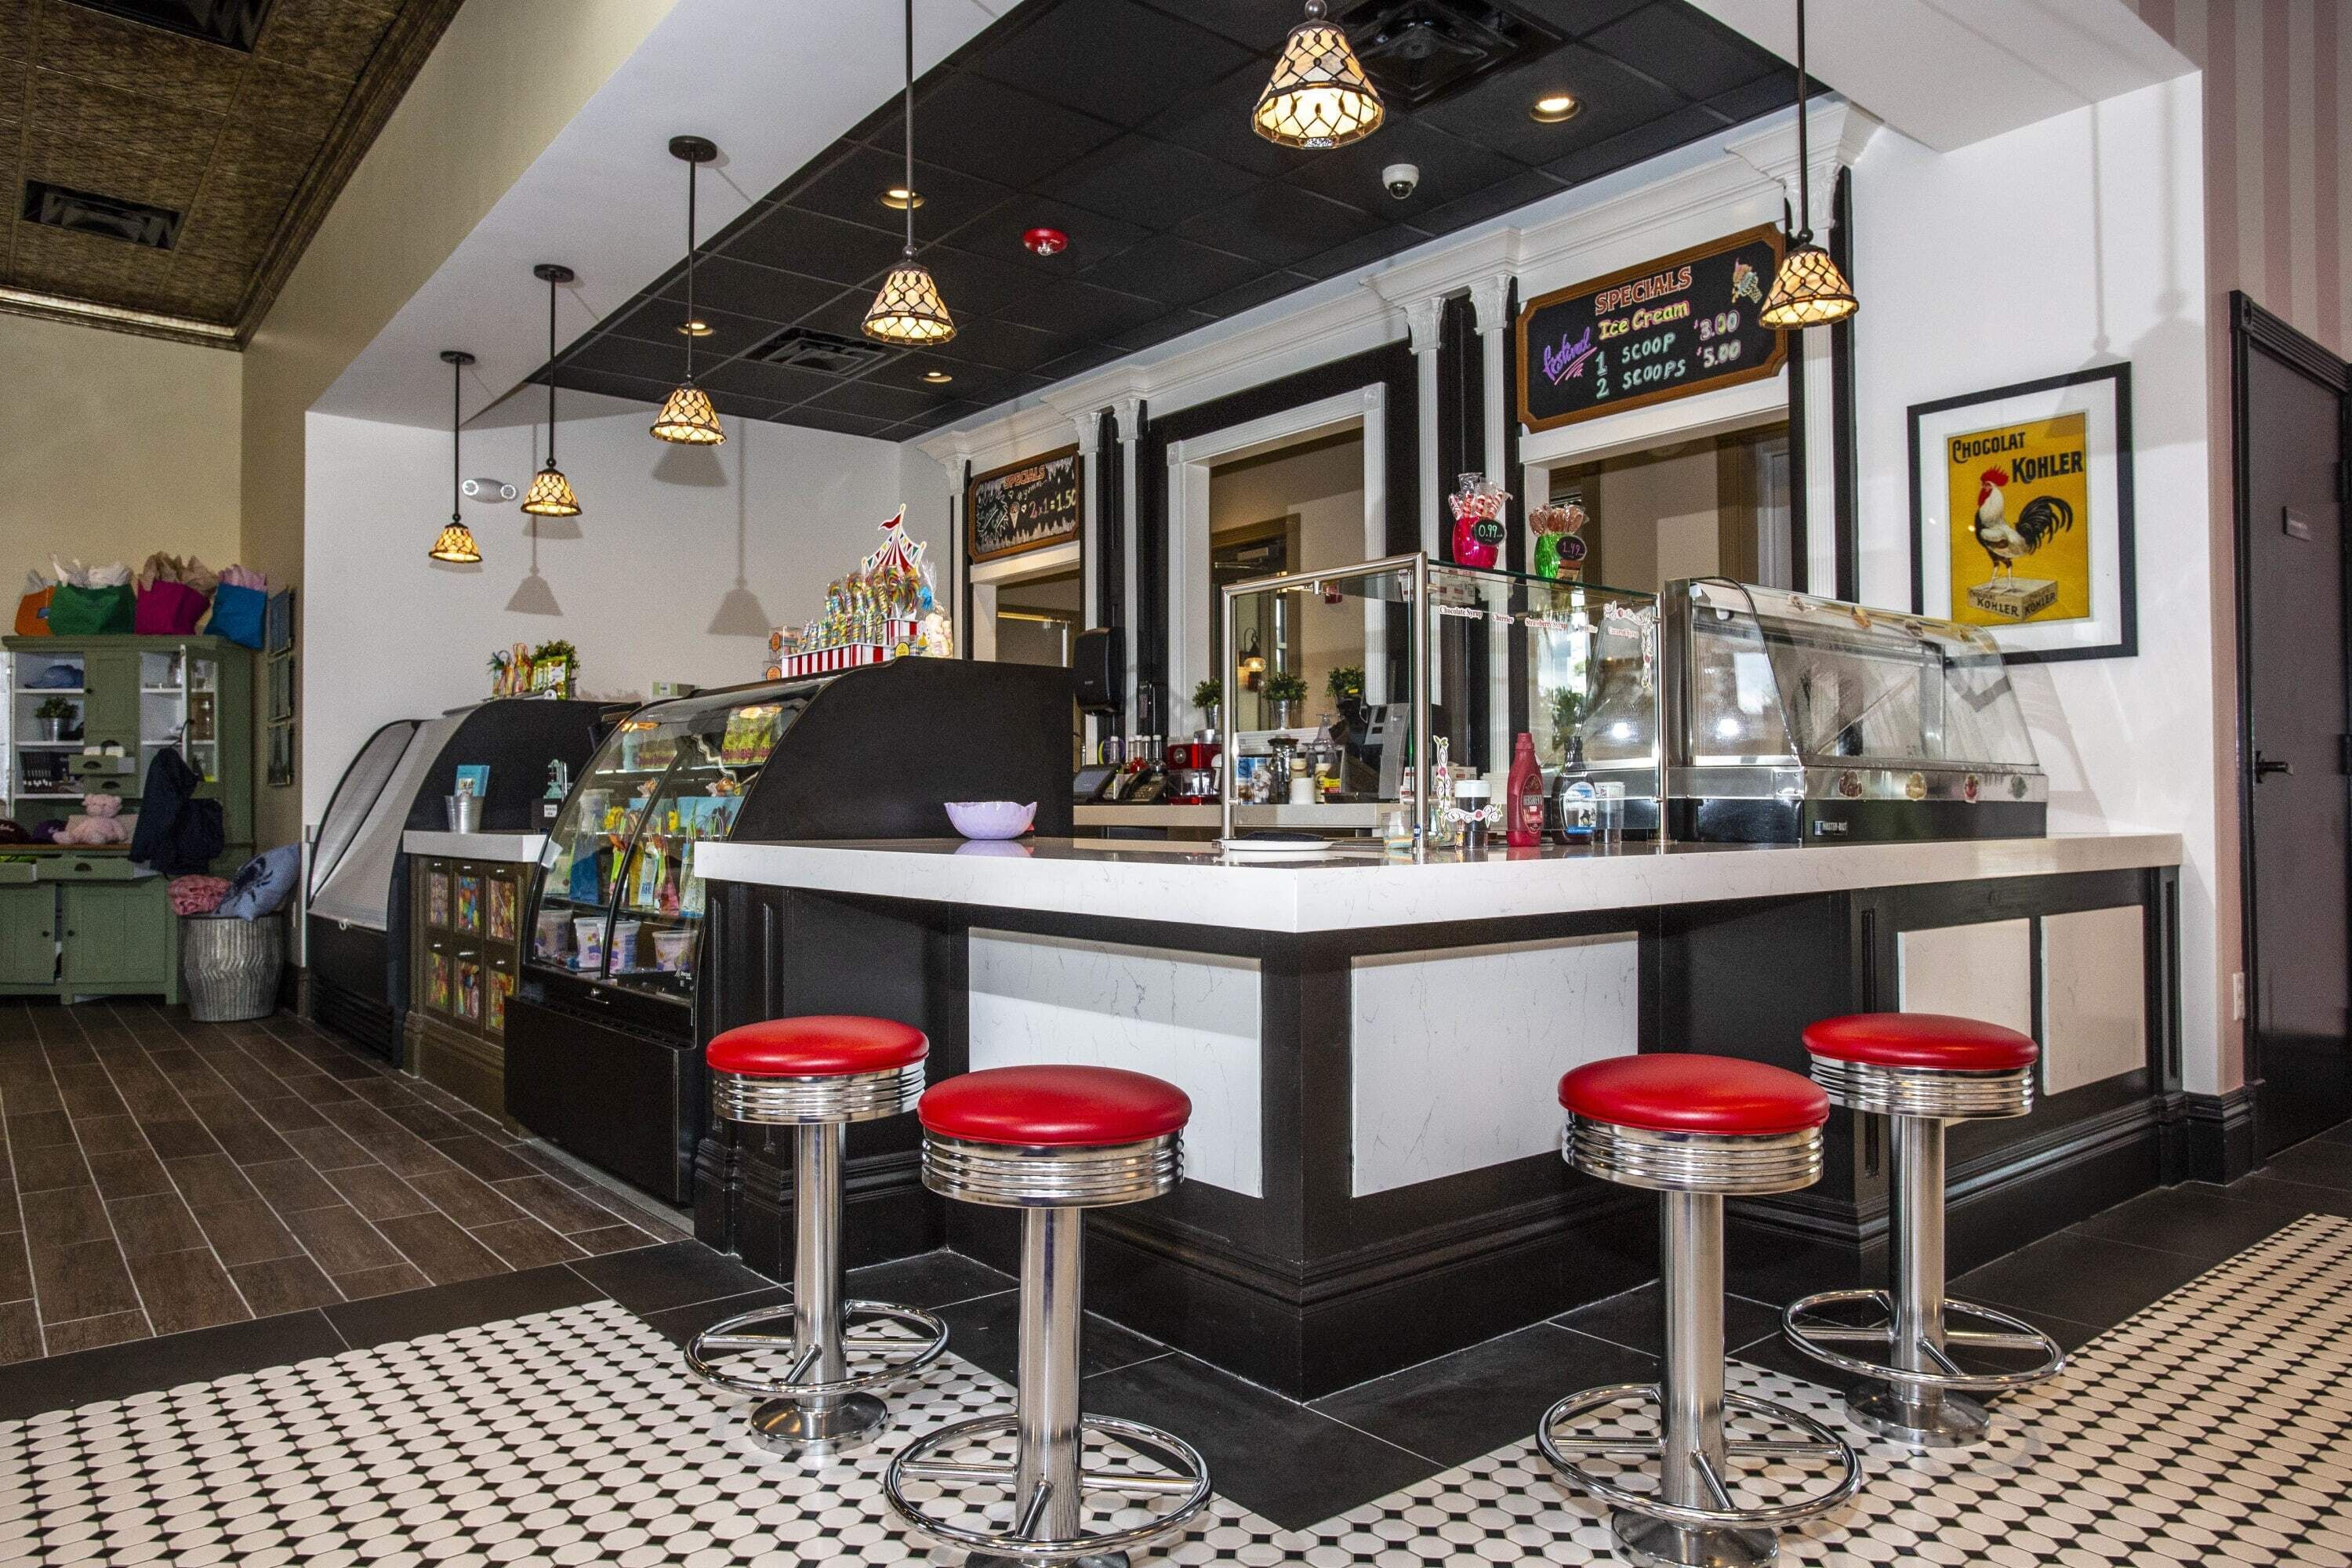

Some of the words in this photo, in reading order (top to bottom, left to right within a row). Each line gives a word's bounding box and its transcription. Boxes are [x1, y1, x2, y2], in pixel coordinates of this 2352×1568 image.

[1595, 266, 1693, 316] SPECIALS
[1598, 318, 1629, 341] Ice
[1632, 300, 1690, 331] Cream
[1595, 351, 1608, 376] 1
[1621, 332, 1676, 364] SCOOP
[1596, 378, 1610, 399] 2
[1622, 358, 1686, 390] SCOOPS
[1952, 432, 2026, 463] CHOCOLAT
[2012, 451, 2084, 485] KOHLER
[1439, 605, 1466, 617] Chocolate
[1466, 608, 1483, 619] Syrup
[1492, 613, 1514, 623] Cherries
[1976, 597, 2020, 617] KOHLER
[2024, 592, 2056, 616] KOHLER
